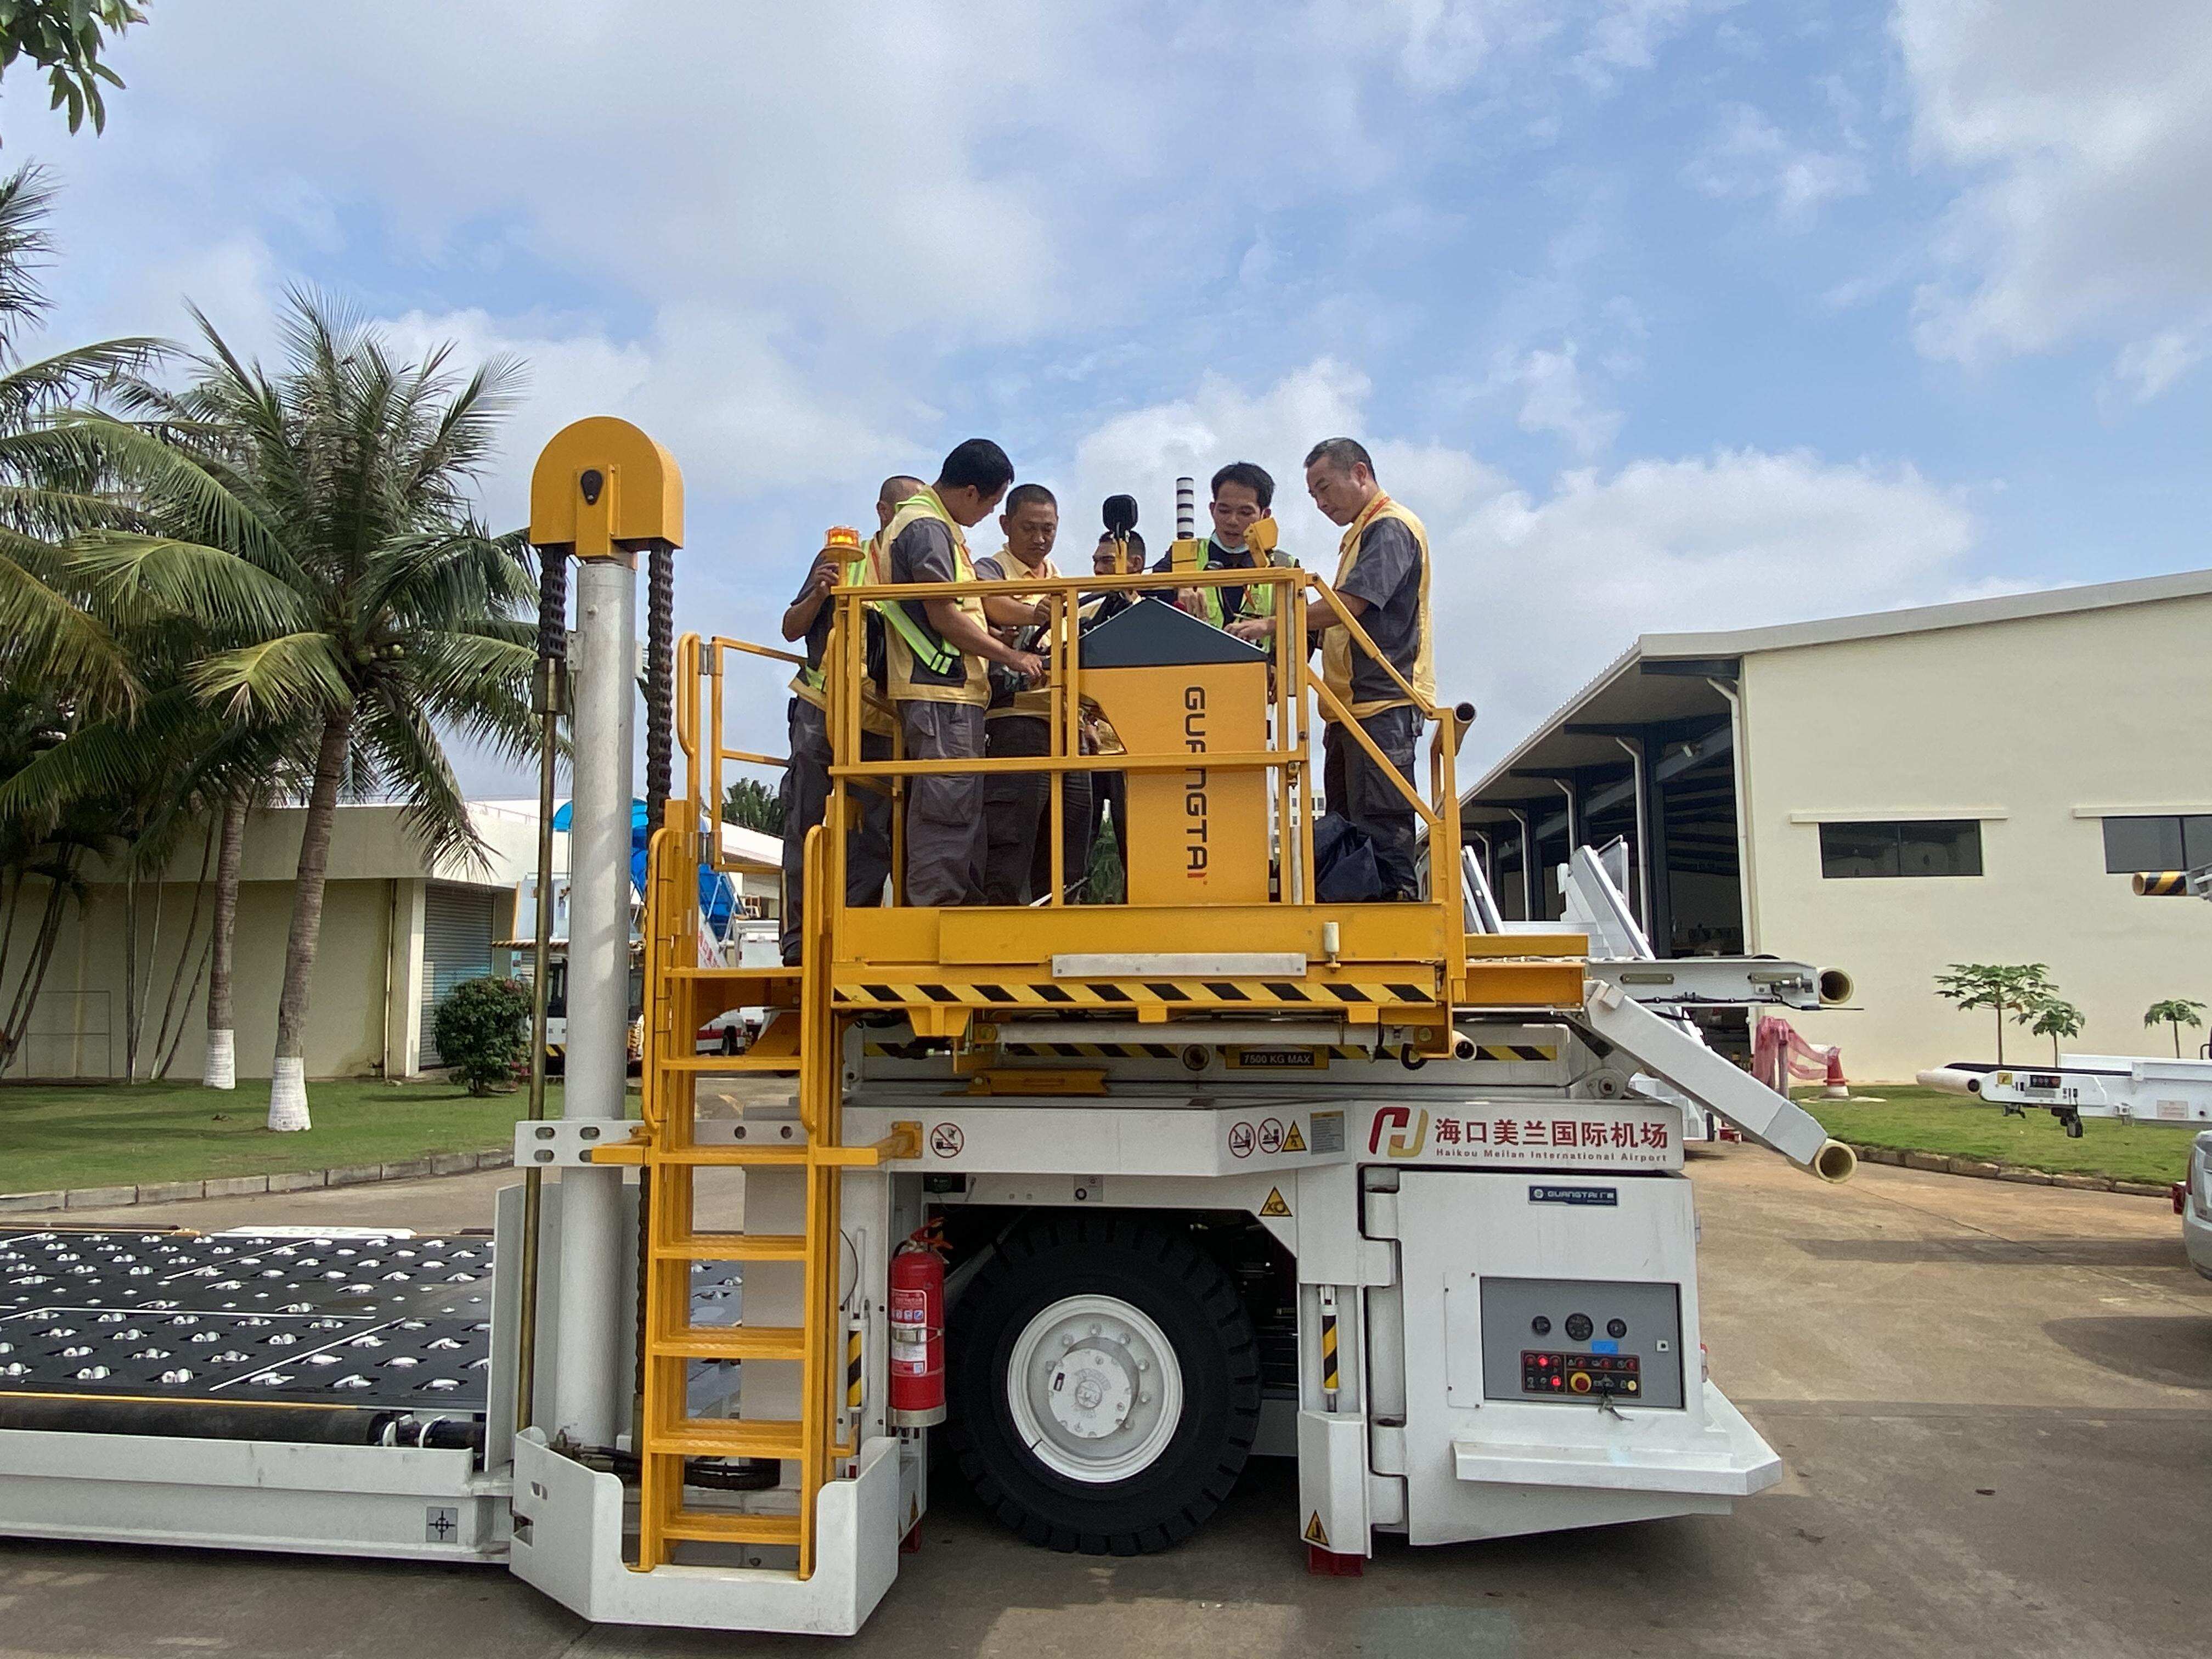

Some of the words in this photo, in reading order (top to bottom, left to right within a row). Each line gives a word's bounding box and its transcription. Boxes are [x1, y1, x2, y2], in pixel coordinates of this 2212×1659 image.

[1269, 1054, 1284, 1064] KG
[1287, 1054, 1311, 1064] MAX
[1435, 1118, 1668, 1149] 海口美兰国际机场
[1436, 1148, 1478, 1158] Haikou
[1483, 1149, 1525, 1159] Meilan
[1531, 1151, 1615, 1160] International
[1621, 1152, 1667, 1163] Airport
